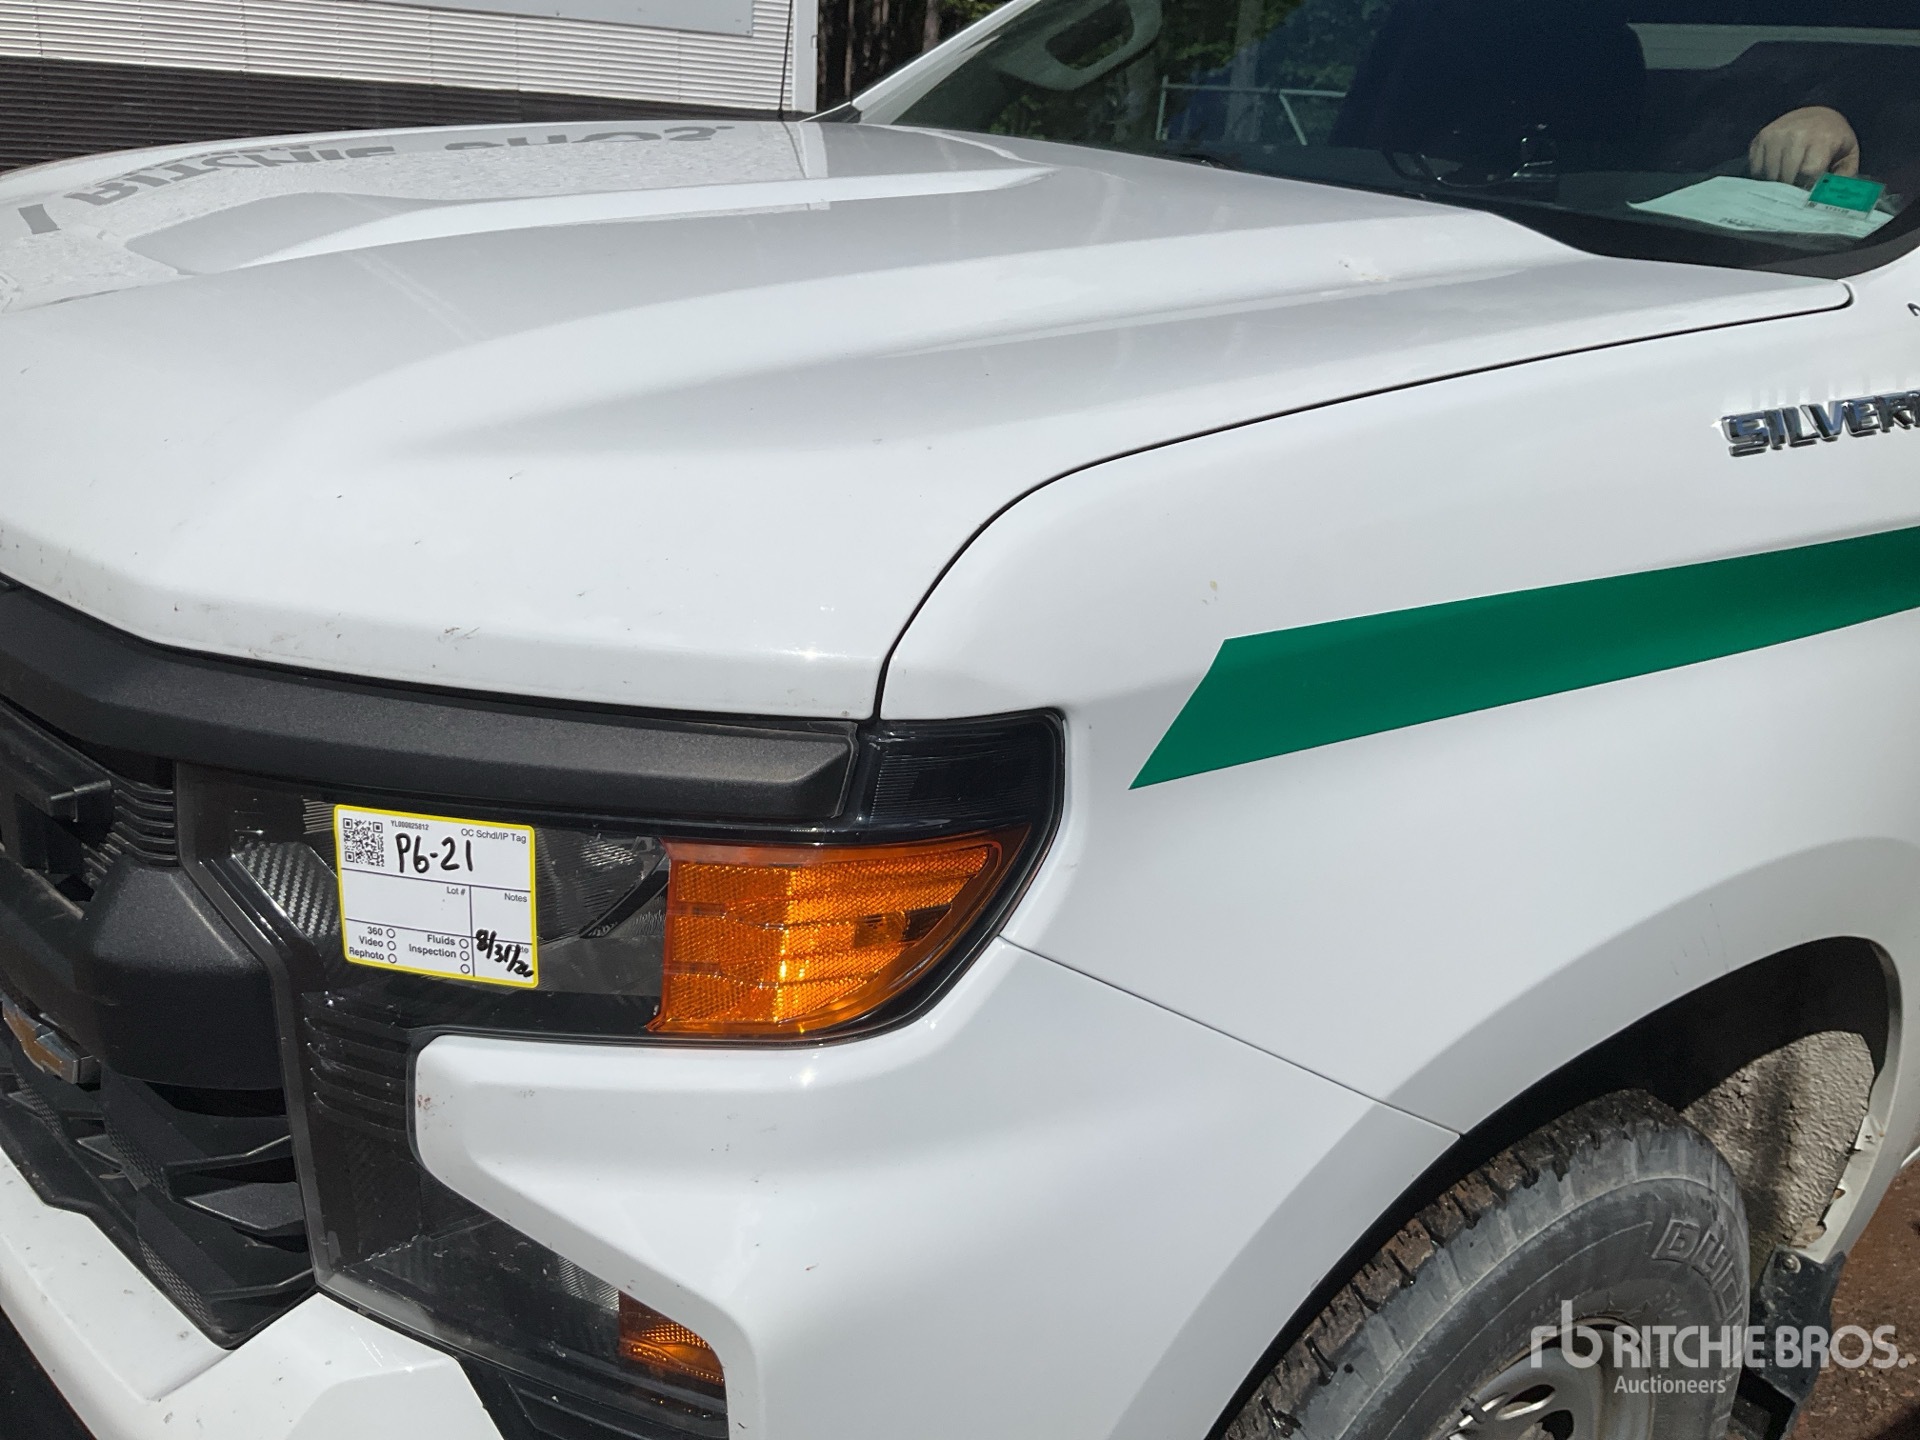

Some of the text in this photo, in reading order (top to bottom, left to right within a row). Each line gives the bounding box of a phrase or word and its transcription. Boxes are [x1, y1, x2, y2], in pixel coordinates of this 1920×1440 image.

[461, 828, 474, 837] OC
[512, 833, 526, 844] Tag
[395, 833, 473, 873] P6-21
[447, 887, 459, 895] Lot
[504, 893, 527, 902] Notes
[367, 927, 383, 935] 360
[359, 936, 383, 947] Video
[427, 935, 455, 945] Fluids
[349, 947, 384, 961] Rephoto
[409, 944, 456, 958] Inspection
